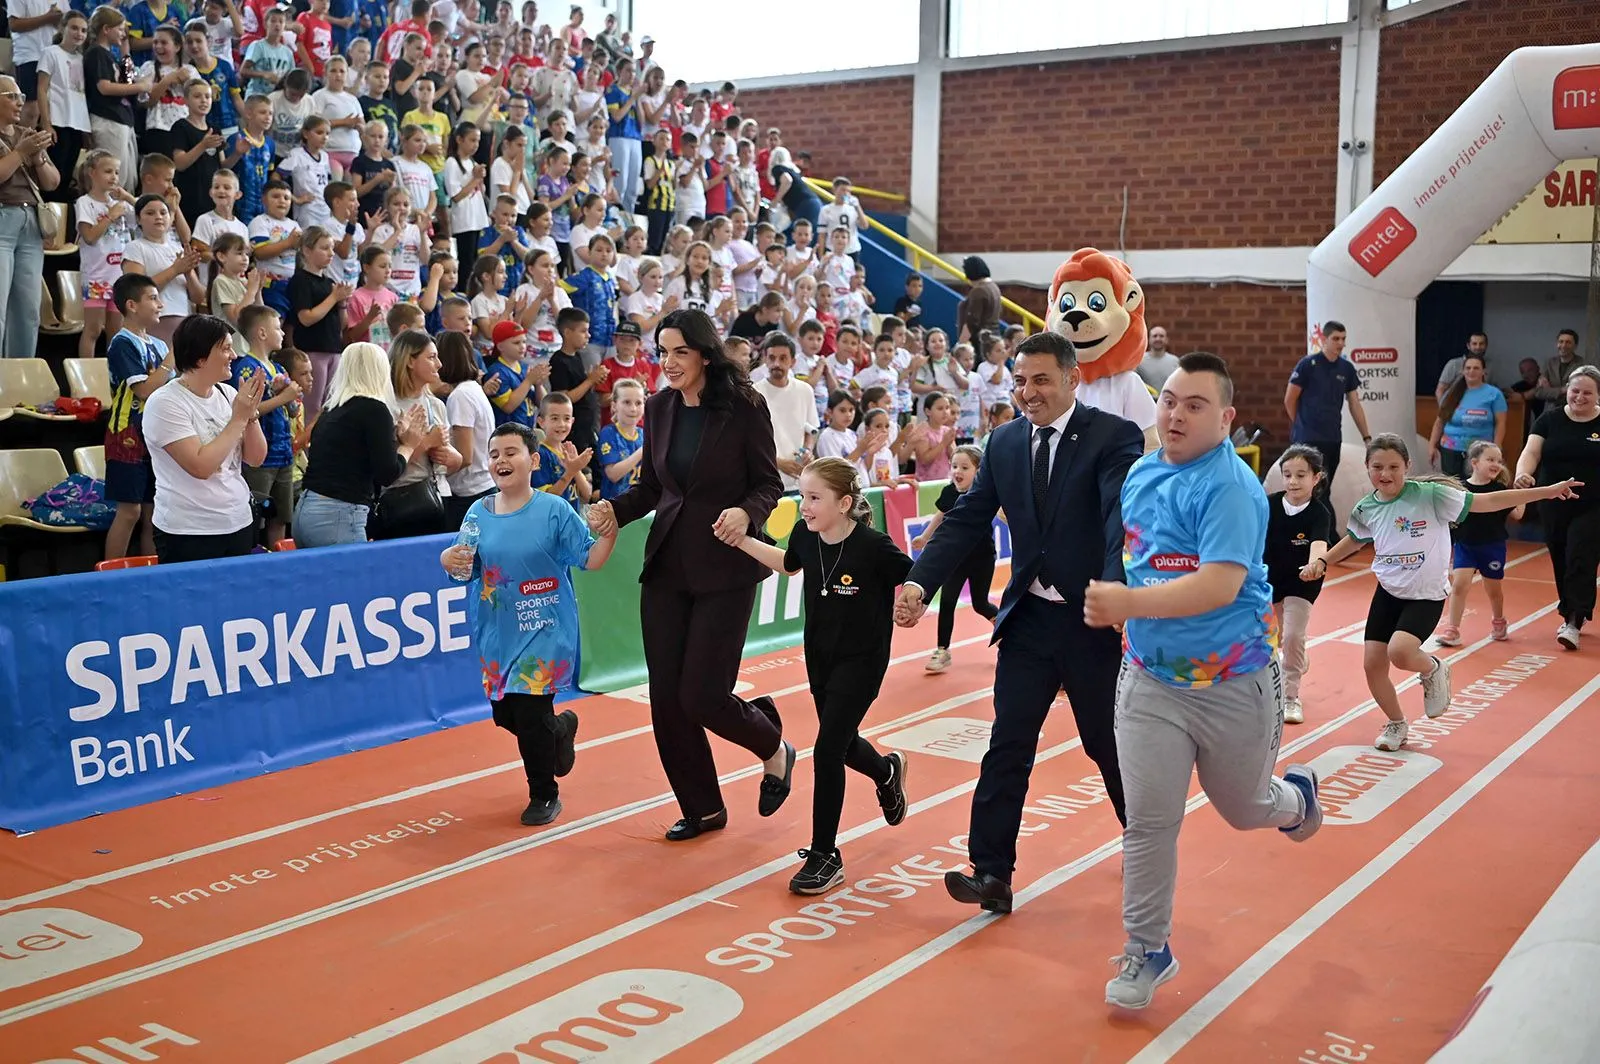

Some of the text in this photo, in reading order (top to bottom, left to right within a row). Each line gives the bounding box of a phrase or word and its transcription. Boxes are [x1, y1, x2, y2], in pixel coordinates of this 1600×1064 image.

[1414, 114, 1506, 209] imate prijatelje!
[1360, 217, 1405, 263] m:tel
[1354, 350, 1394, 362] plazma
[1357, 367, 1400, 378] ORTSKE
[515, 594, 561, 611] SPORTSKE
[517, 609, 541, 621] IGRE
[65, 585, 471, 722] SPARKASSE
[1454, 679, 1519, 702] IGRE
[70, 718, 195, 787] Bank
[150, 810, 464, 910] imate prijatelje!
[706, 853, 969, 974] SPORTSKE
